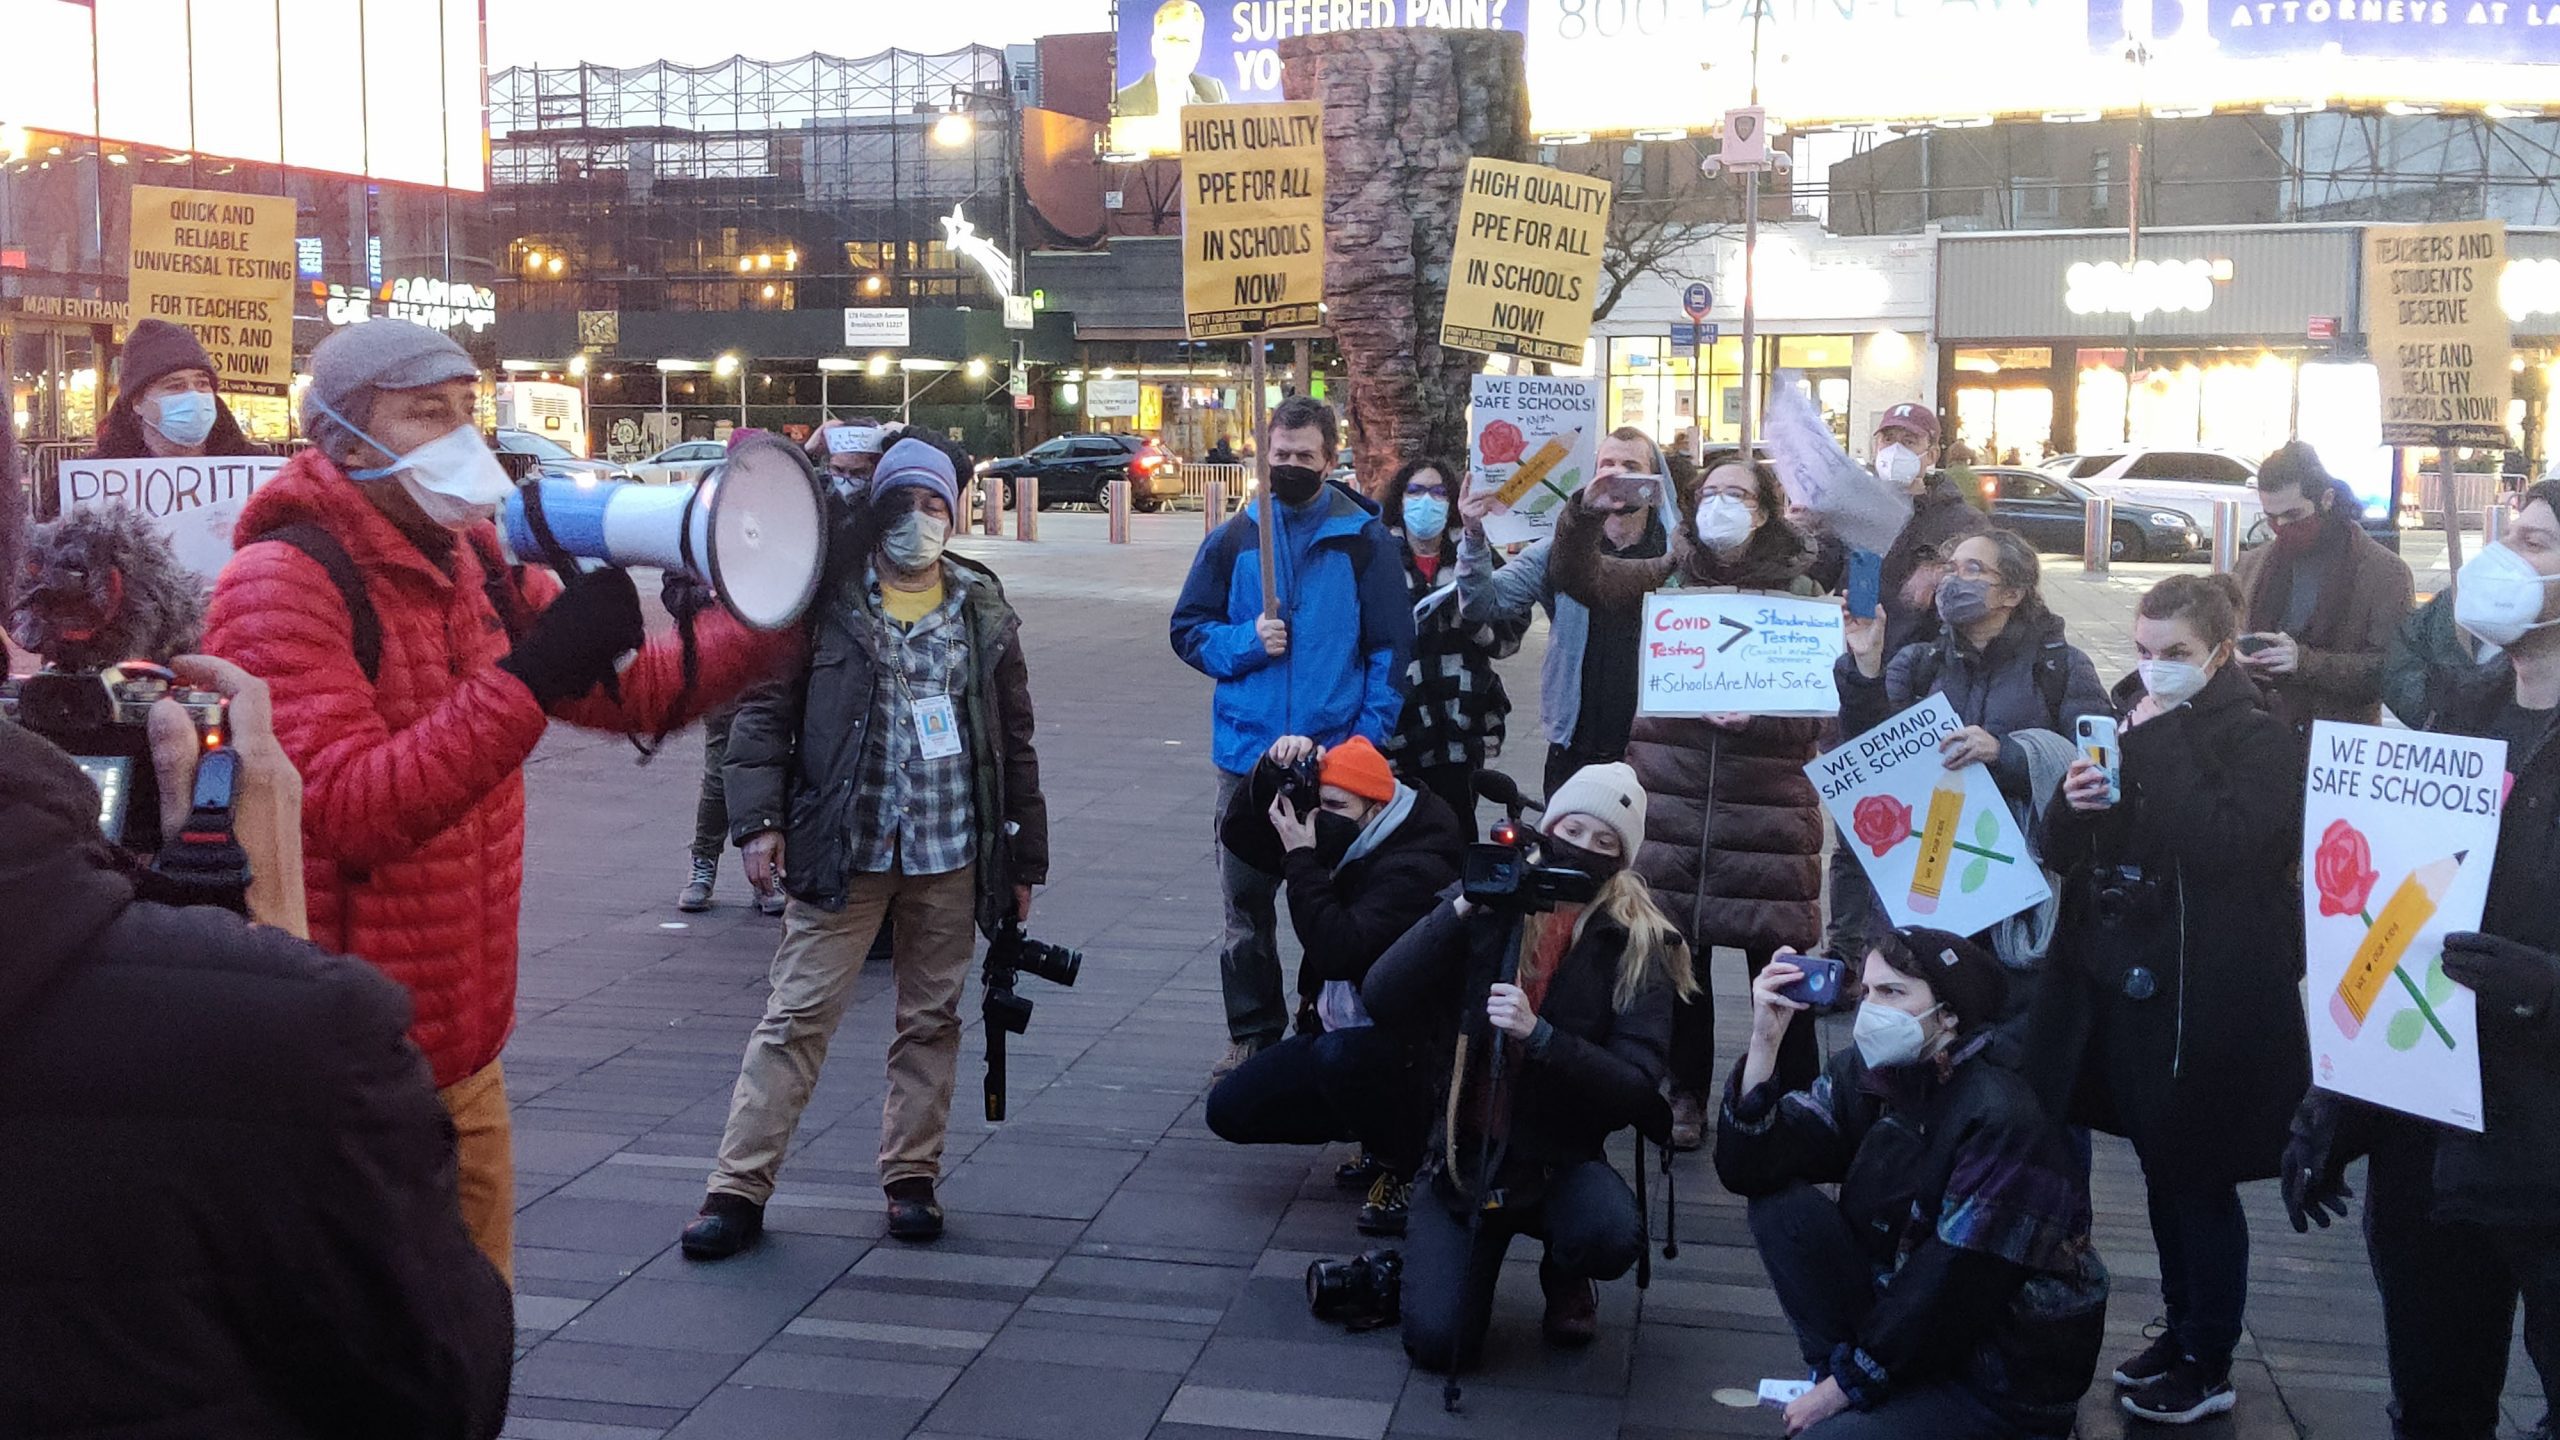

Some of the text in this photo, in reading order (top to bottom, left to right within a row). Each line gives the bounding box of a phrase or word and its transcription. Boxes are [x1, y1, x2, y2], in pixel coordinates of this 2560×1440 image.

[1232, 0, 1508, 43] SUFFERED PAIN?
[2230, 0, 2560, 27] ATTORNEYS AT LA
[1233, 48, 1286, 91] YO
[1185, 115, 1320, 151] HIGH QUALITY
[1198, 167, 1312, 204] PPE FOR ALL
[1470, 168, 1606, 215] HIGH QUALITY
[170, 201, 254, 225] QUICK AND
[175, 228, 249, 251] RELIABLE
[1203, 223, 1312, 261] IN SCHOOLS
[1472, 212, 1590, 256] PPE FOR ALL
[2458, 233, 2494, 260] AND
[134, 250, 292, 280] UNIVERSAL TESTING
[1467, 258, 1582, 301] IN SCHOOLS
[1234, 272, 1287, 305] NOW!
[23, 295, 129, 319] MAIN ENTRANC
[151, 294, 272, 323] FOR TEACHERS,
[1492, 302, 1544, 335] NOW!
[239, 328, 272, 349] AND
[2440, 343, 2473, 368] AND
[227, 353, 269, 375] NOW!
[1474, 395, 1595, 412] SAFE SCHOOLS!
[1485, 380, 1585, 396] WE DEMAND
[2456, 396, 2498, 422] NOW!
[70, 464, 281, 517] PRIORITI
[1650, 630, 1820, 669] Testing Testing
[1821, 718, 1959, 800] SAFE SCHOOLS!
[1822, 708, 1937, 777] WE DEMAND
[2331, 735, 2483, 779] WE DEMAND
[2312, 767, 2497, 817] SAFE SCHOOLS!
[2373, 943, 2384, 963] OUR
[2384, 921, 2399, 943] KIDS
